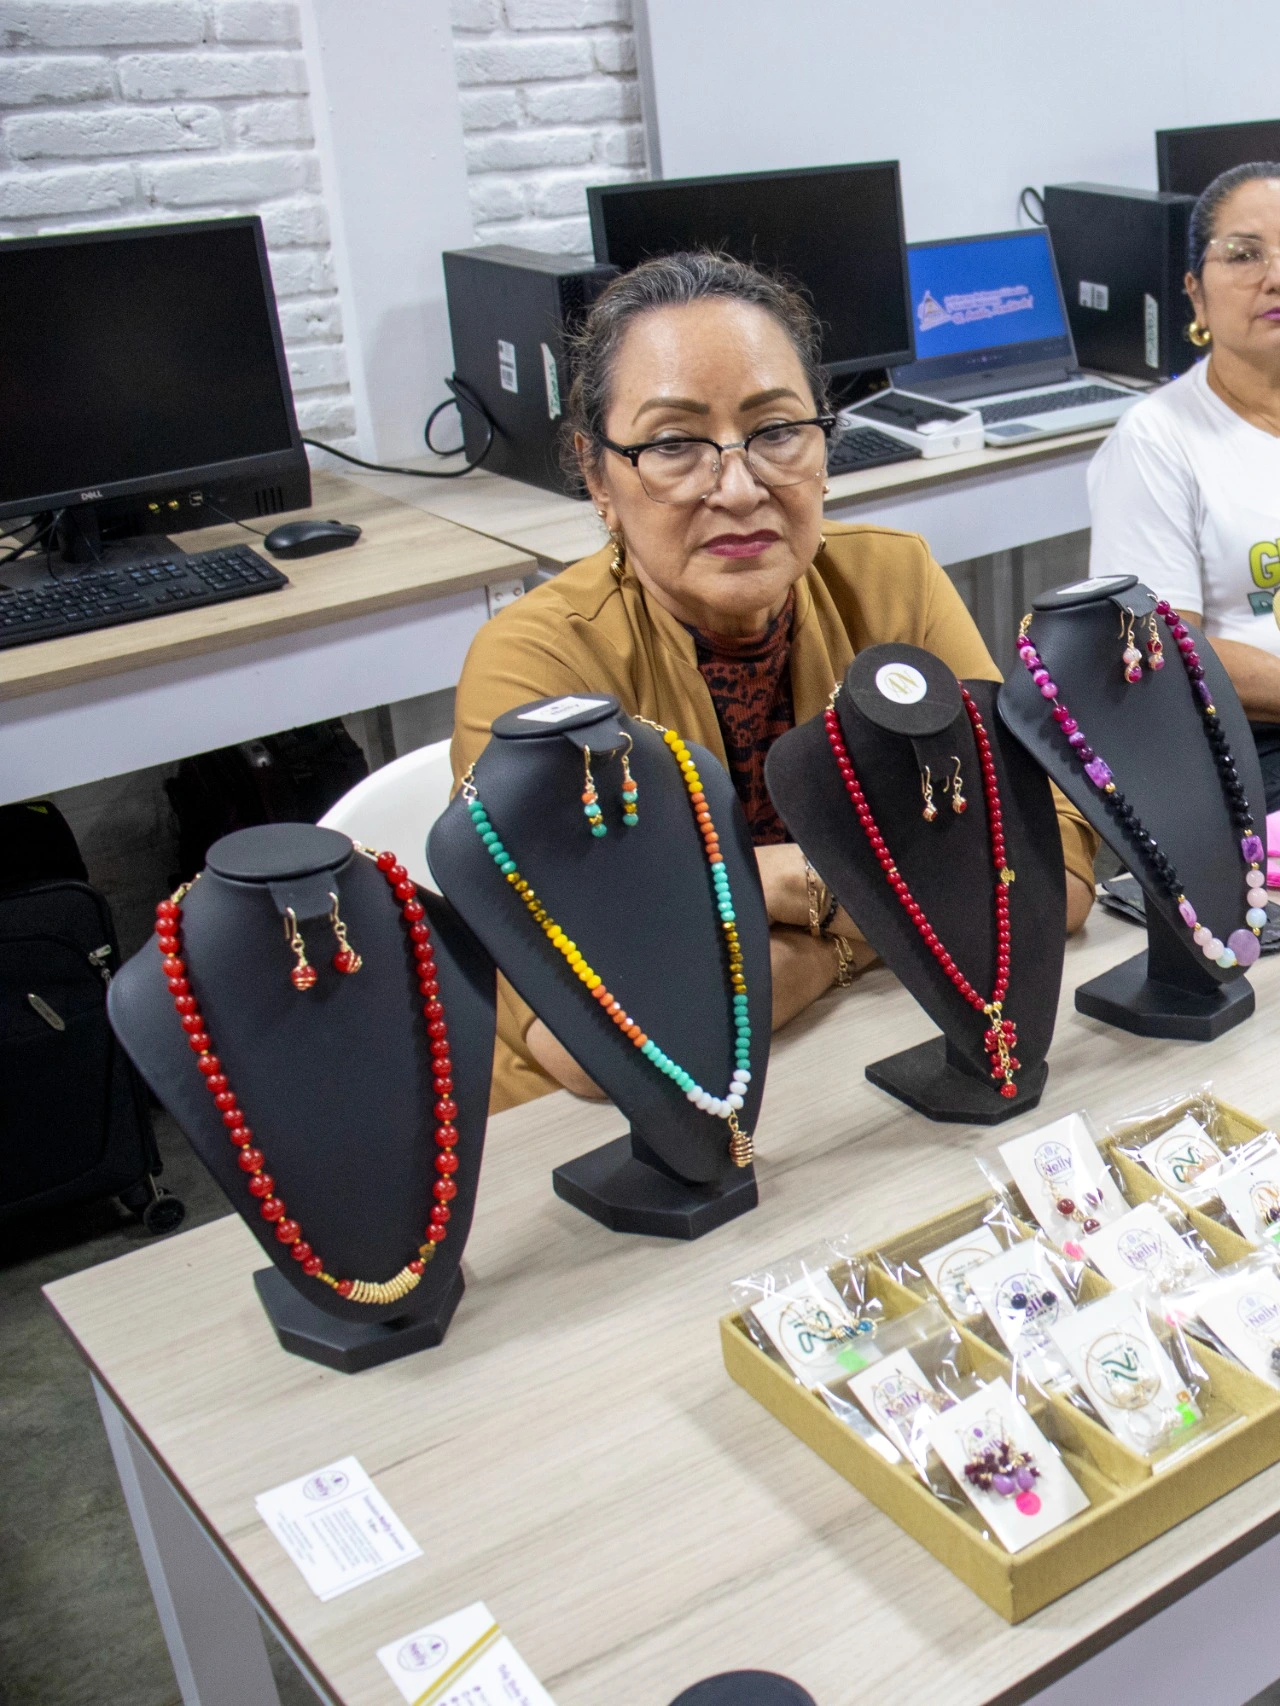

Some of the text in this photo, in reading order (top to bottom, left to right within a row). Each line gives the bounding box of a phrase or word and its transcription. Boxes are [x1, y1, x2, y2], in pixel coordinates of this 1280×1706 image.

[1042, 1156, 1072, 1175] Nelly
[1127, 1241, 1158, 1266] Nelly
[1248, 1304, 1279, 1326] Nelly
